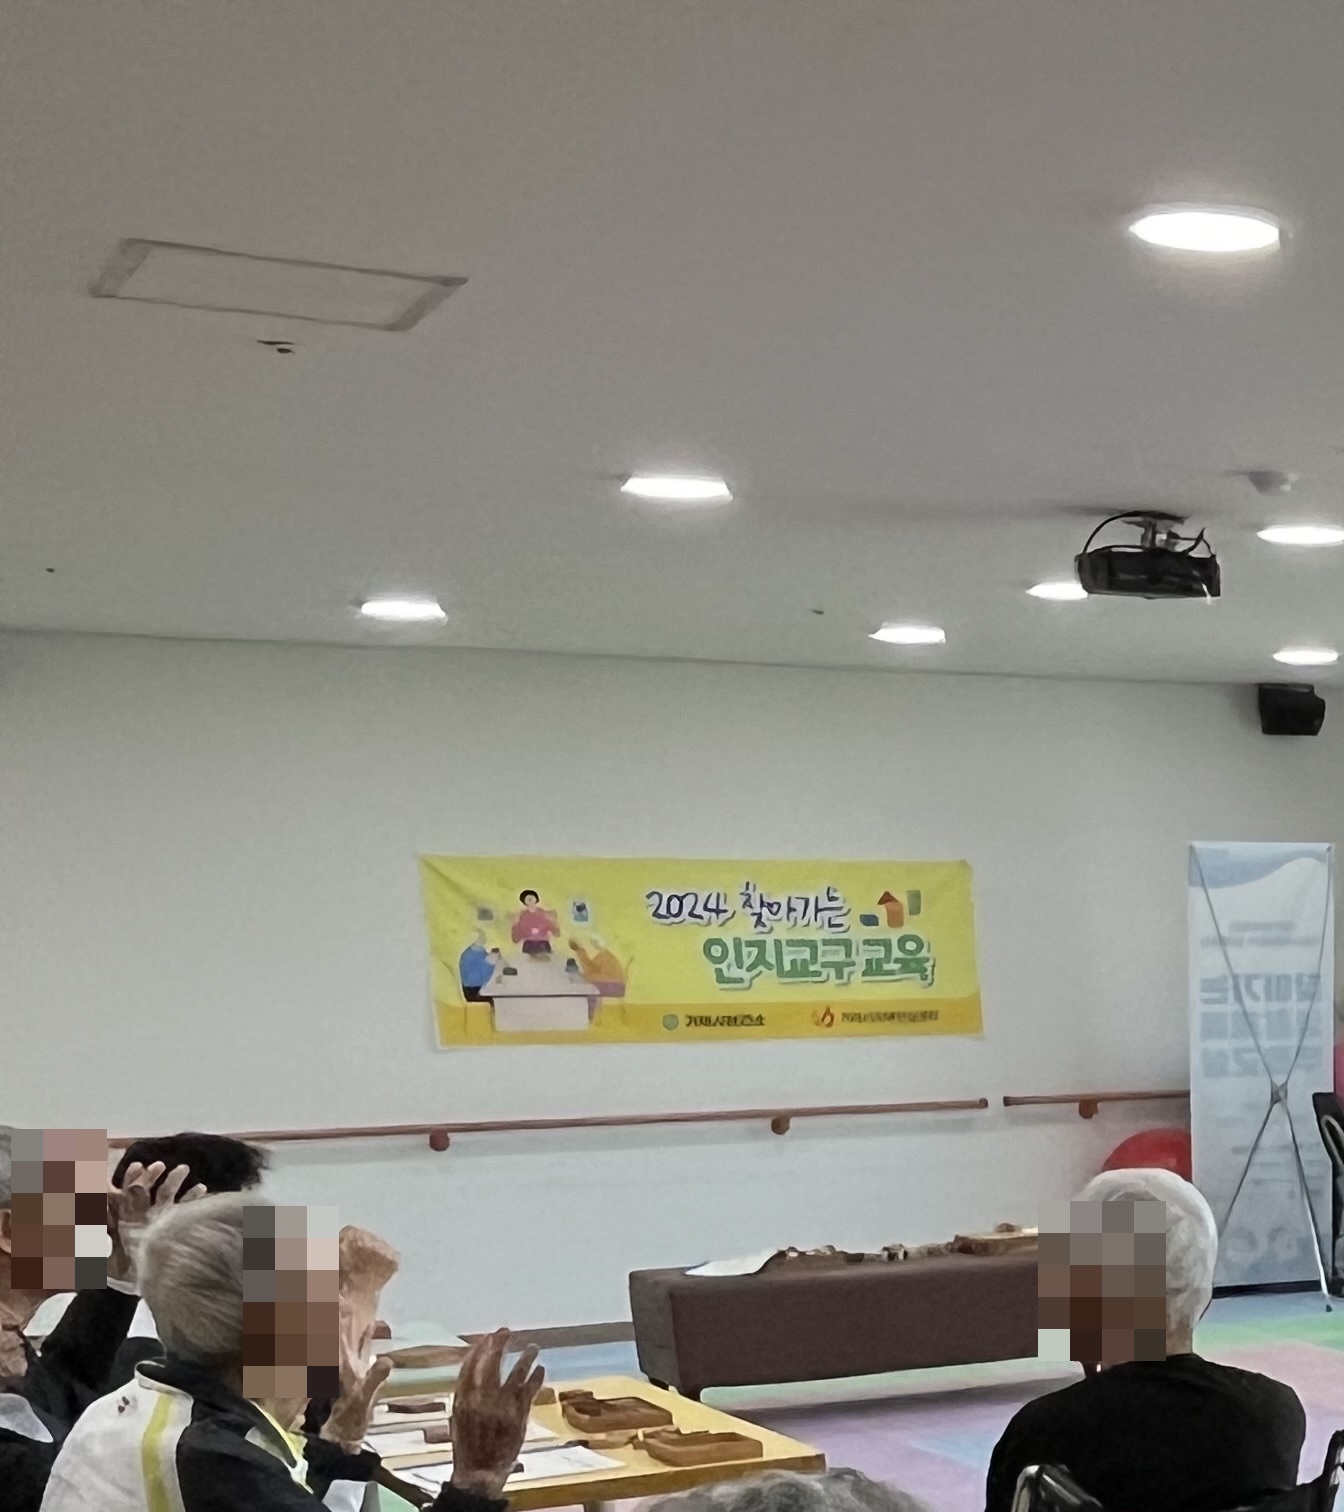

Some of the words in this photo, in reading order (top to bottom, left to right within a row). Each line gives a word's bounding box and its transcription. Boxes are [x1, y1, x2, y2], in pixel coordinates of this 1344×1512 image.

[646, 890, 729, 921] 2024
[739, 881, 846, 929] 찾아가는
[702, 937, 856, 985] 인지교구
[860, 933, 932, 982] 교육
